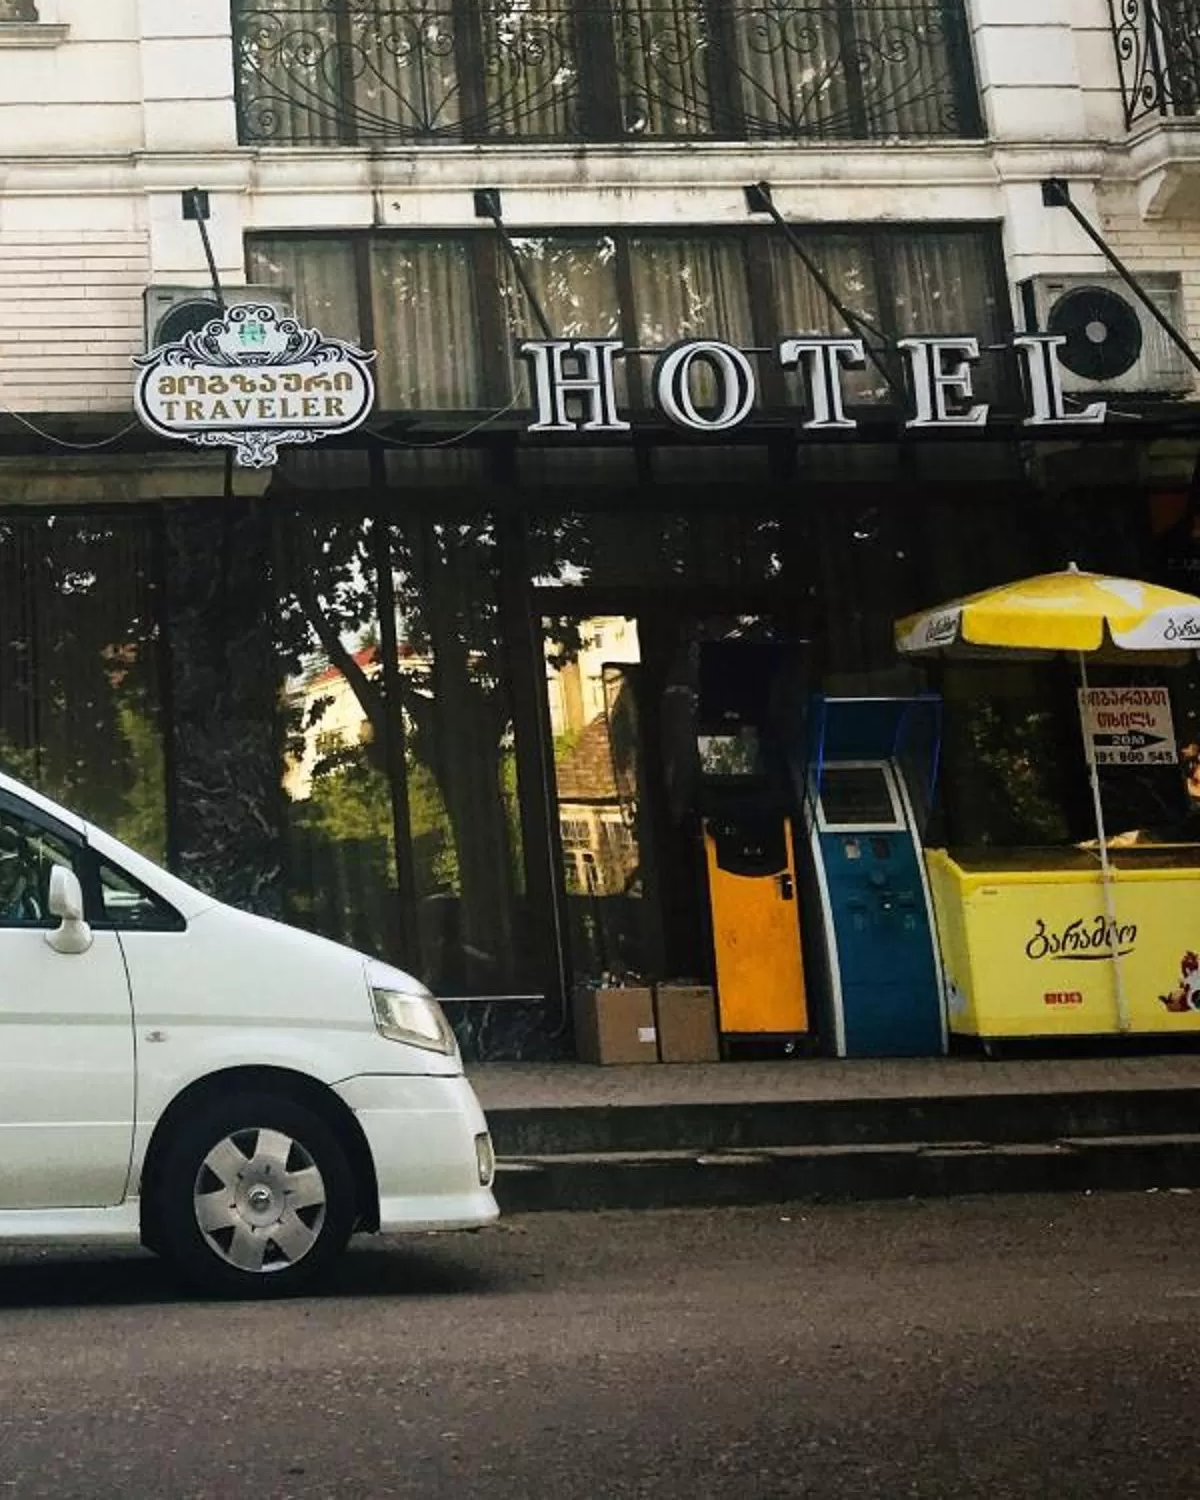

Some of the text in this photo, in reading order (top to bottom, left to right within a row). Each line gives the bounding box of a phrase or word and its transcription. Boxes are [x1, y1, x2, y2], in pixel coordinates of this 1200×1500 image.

[157, 371, 354, 396] მოგზაური
[519, 334, 1107, 432] HOTEL
[159, 396, 346, 421] TRAVELER
